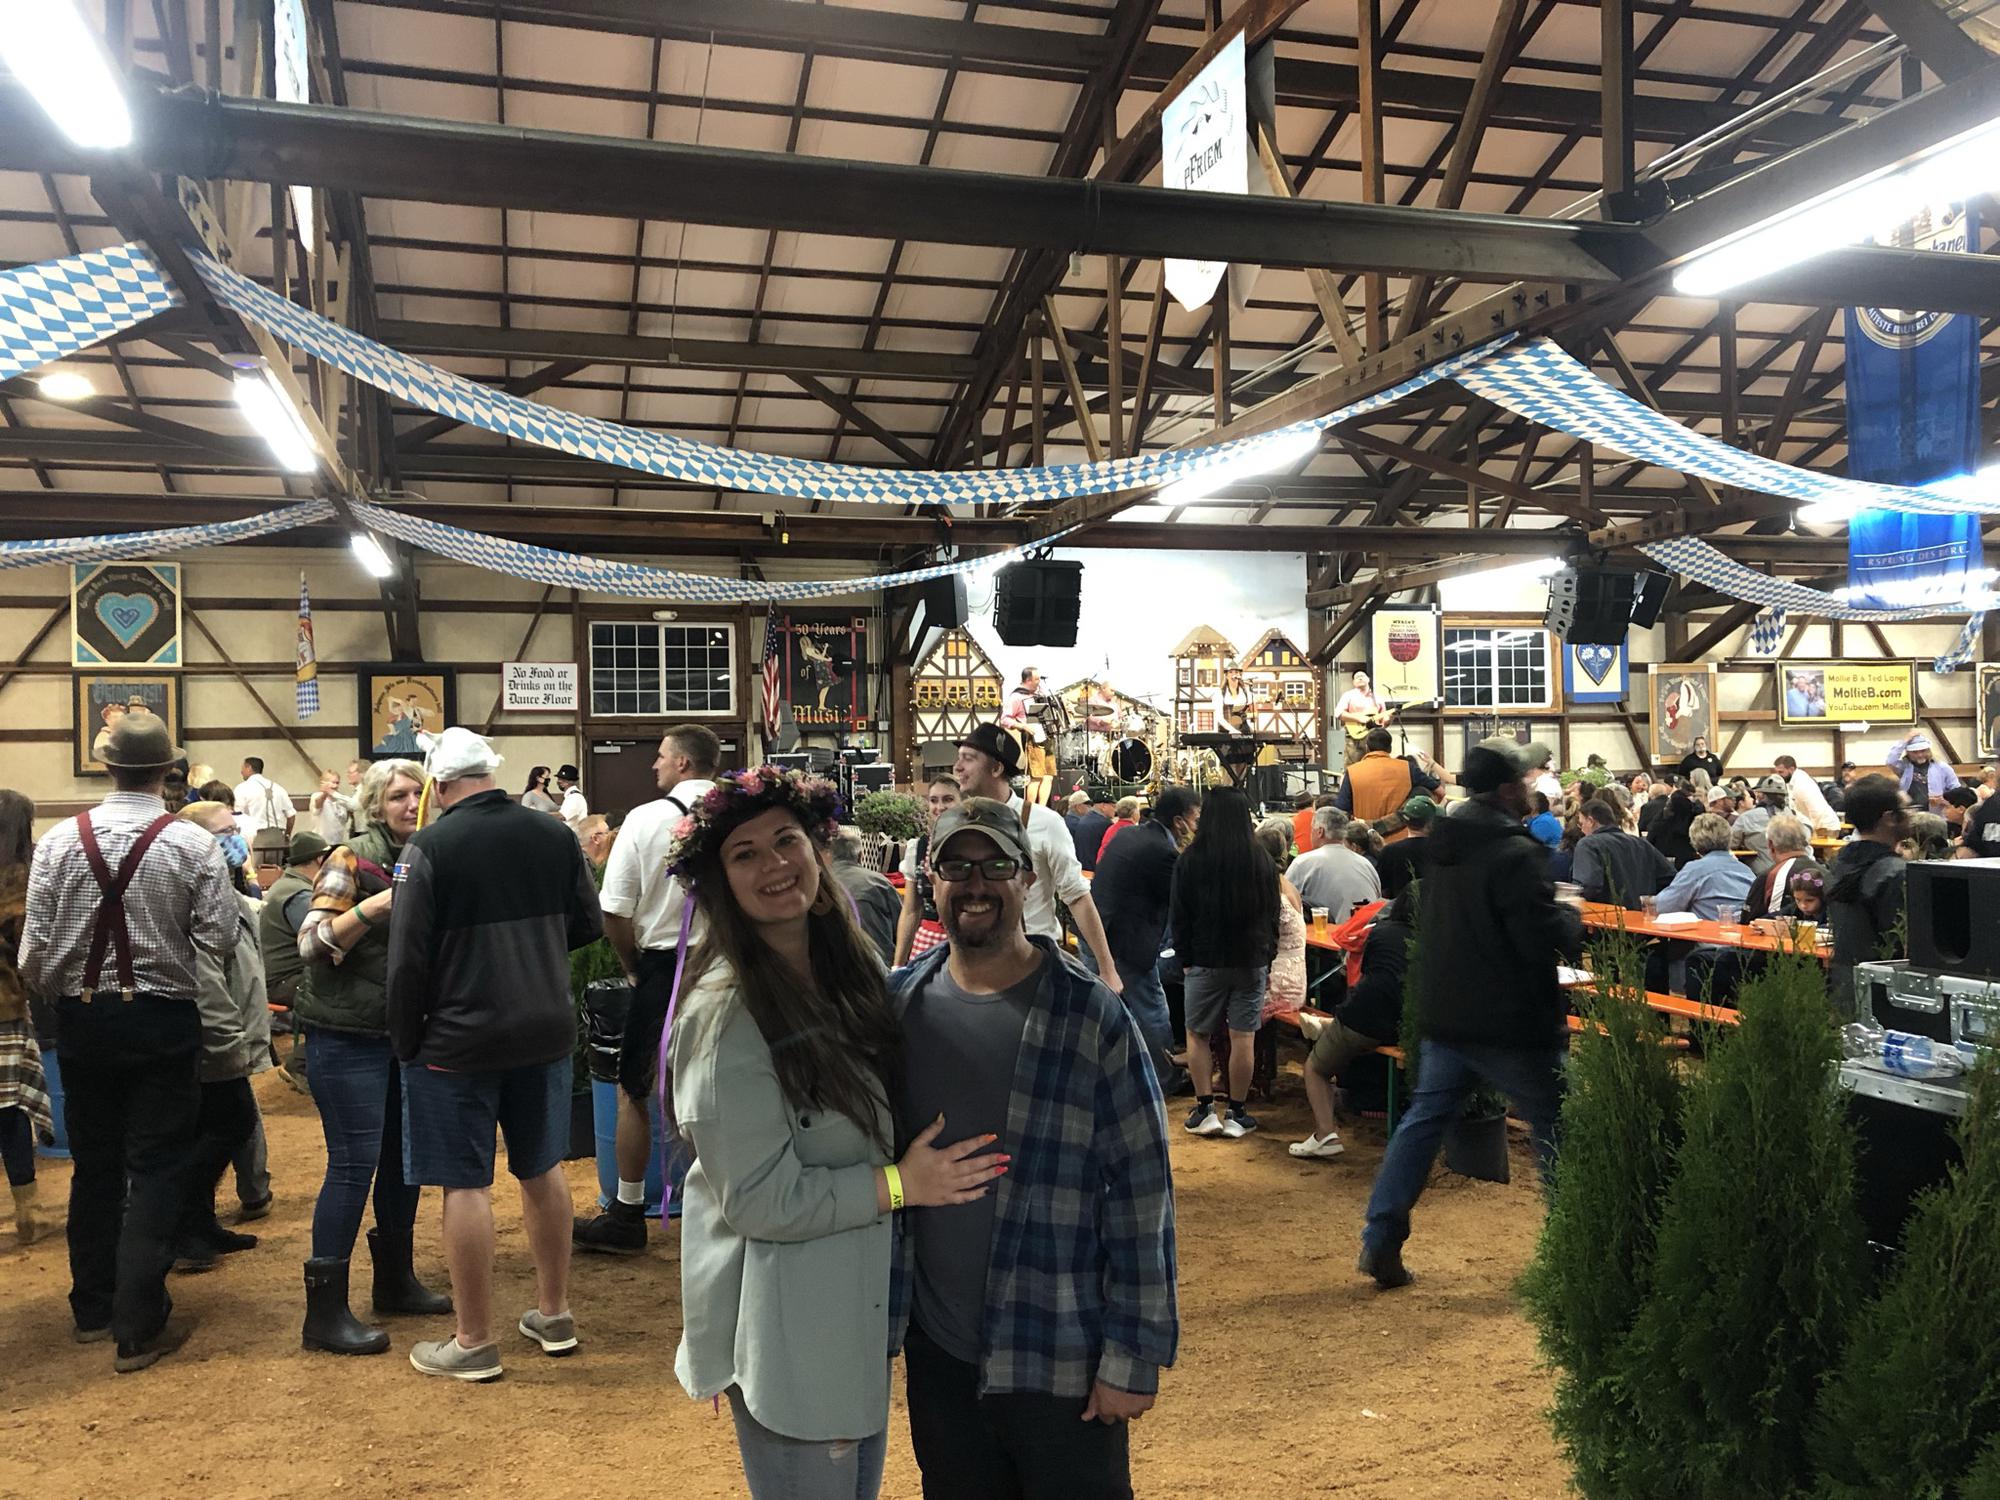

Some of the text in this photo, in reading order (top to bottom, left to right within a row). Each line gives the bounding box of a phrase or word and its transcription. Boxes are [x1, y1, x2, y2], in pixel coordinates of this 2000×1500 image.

[795, 622, 846, 639] 50 Years
[513, 667, 568, 679] No Food or
[800, 664, 812, 681] of
[1828, 674, 1850, 682] Mollie
[1852, 674, 1858, 682] B
[1868, 673, 1882, 682] Ted
[508, 679, 573, 692] Drinks on the
[508, 693, 573, 704] Dance Floor
[1833, 687, 1902, 699] MollieB.com
